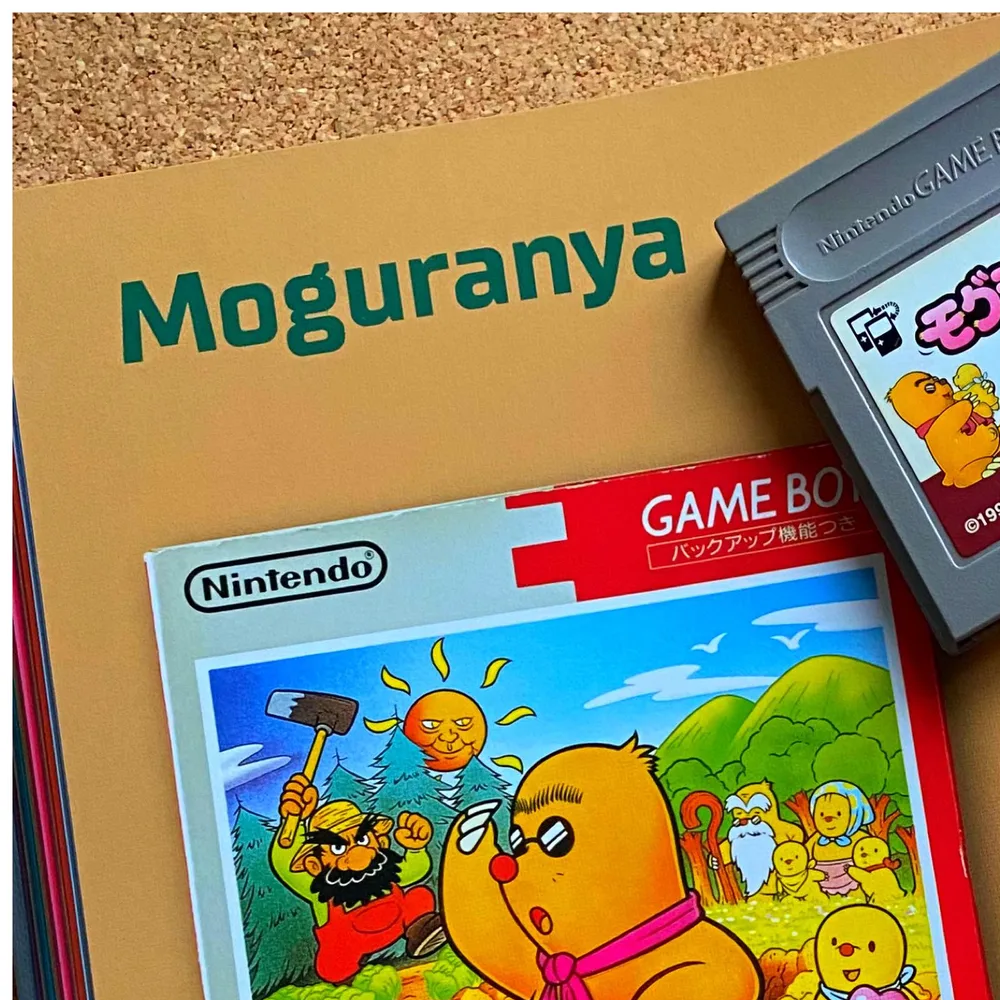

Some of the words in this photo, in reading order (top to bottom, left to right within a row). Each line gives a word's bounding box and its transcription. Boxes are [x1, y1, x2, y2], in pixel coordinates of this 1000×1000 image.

[816, 192, 915, 257] Nintendo
[913, 136, 993, 199] GAME
[121, 216, 686, 364] Moguranya
[641, 477, 776, 537] GAME
[671, 515, 856, 562] バックアップ機能つき
[202, 556, 373, 601] Nintendo
